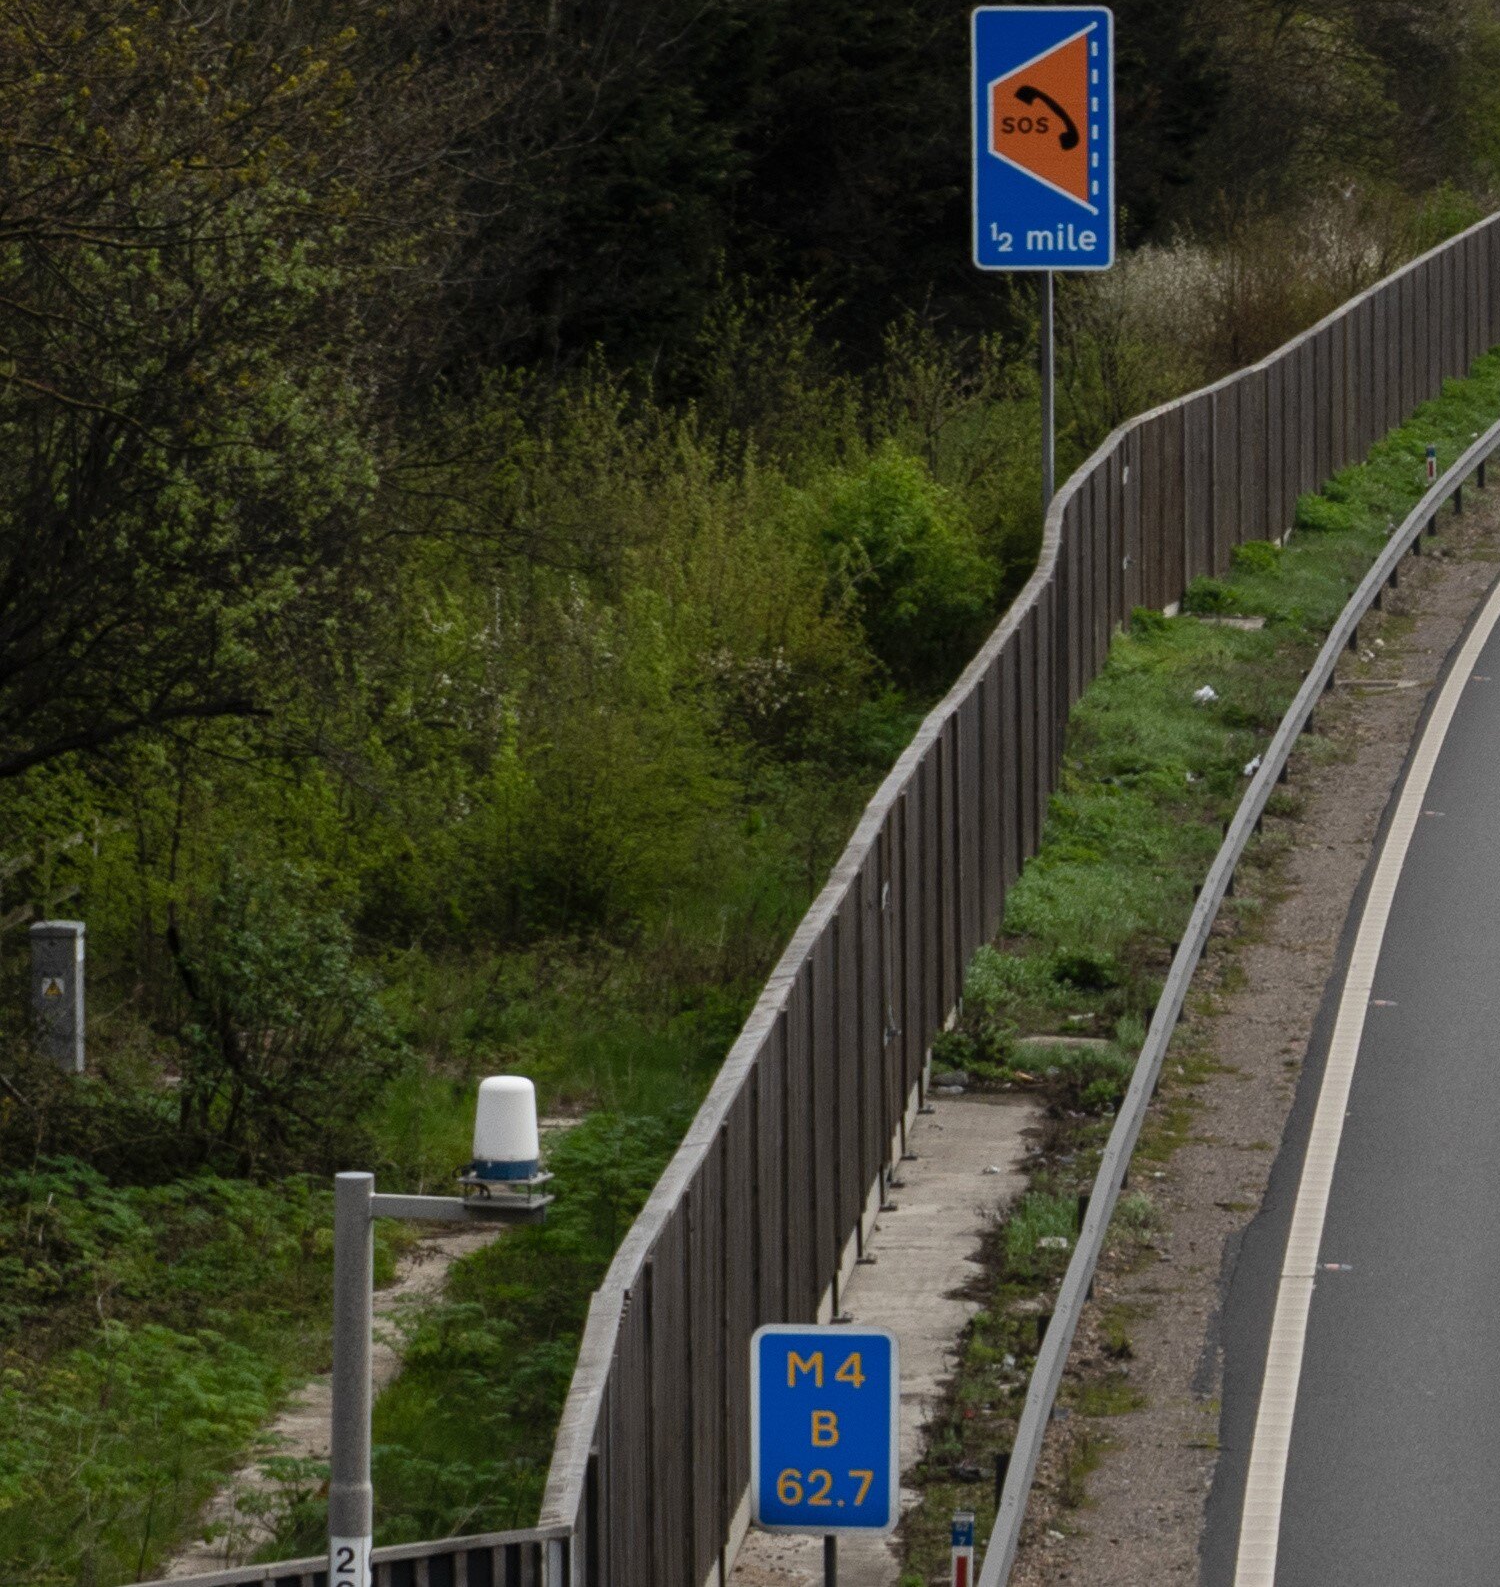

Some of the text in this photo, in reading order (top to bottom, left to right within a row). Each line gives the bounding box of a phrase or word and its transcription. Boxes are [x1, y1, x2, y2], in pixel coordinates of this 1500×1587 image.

[1001, 116, 1050, 135] SOS
[1026, 223, 1098, 252] mile
[810, 1409, 840, 1448] B
[776, 1468, 875, 1508] 62.7
